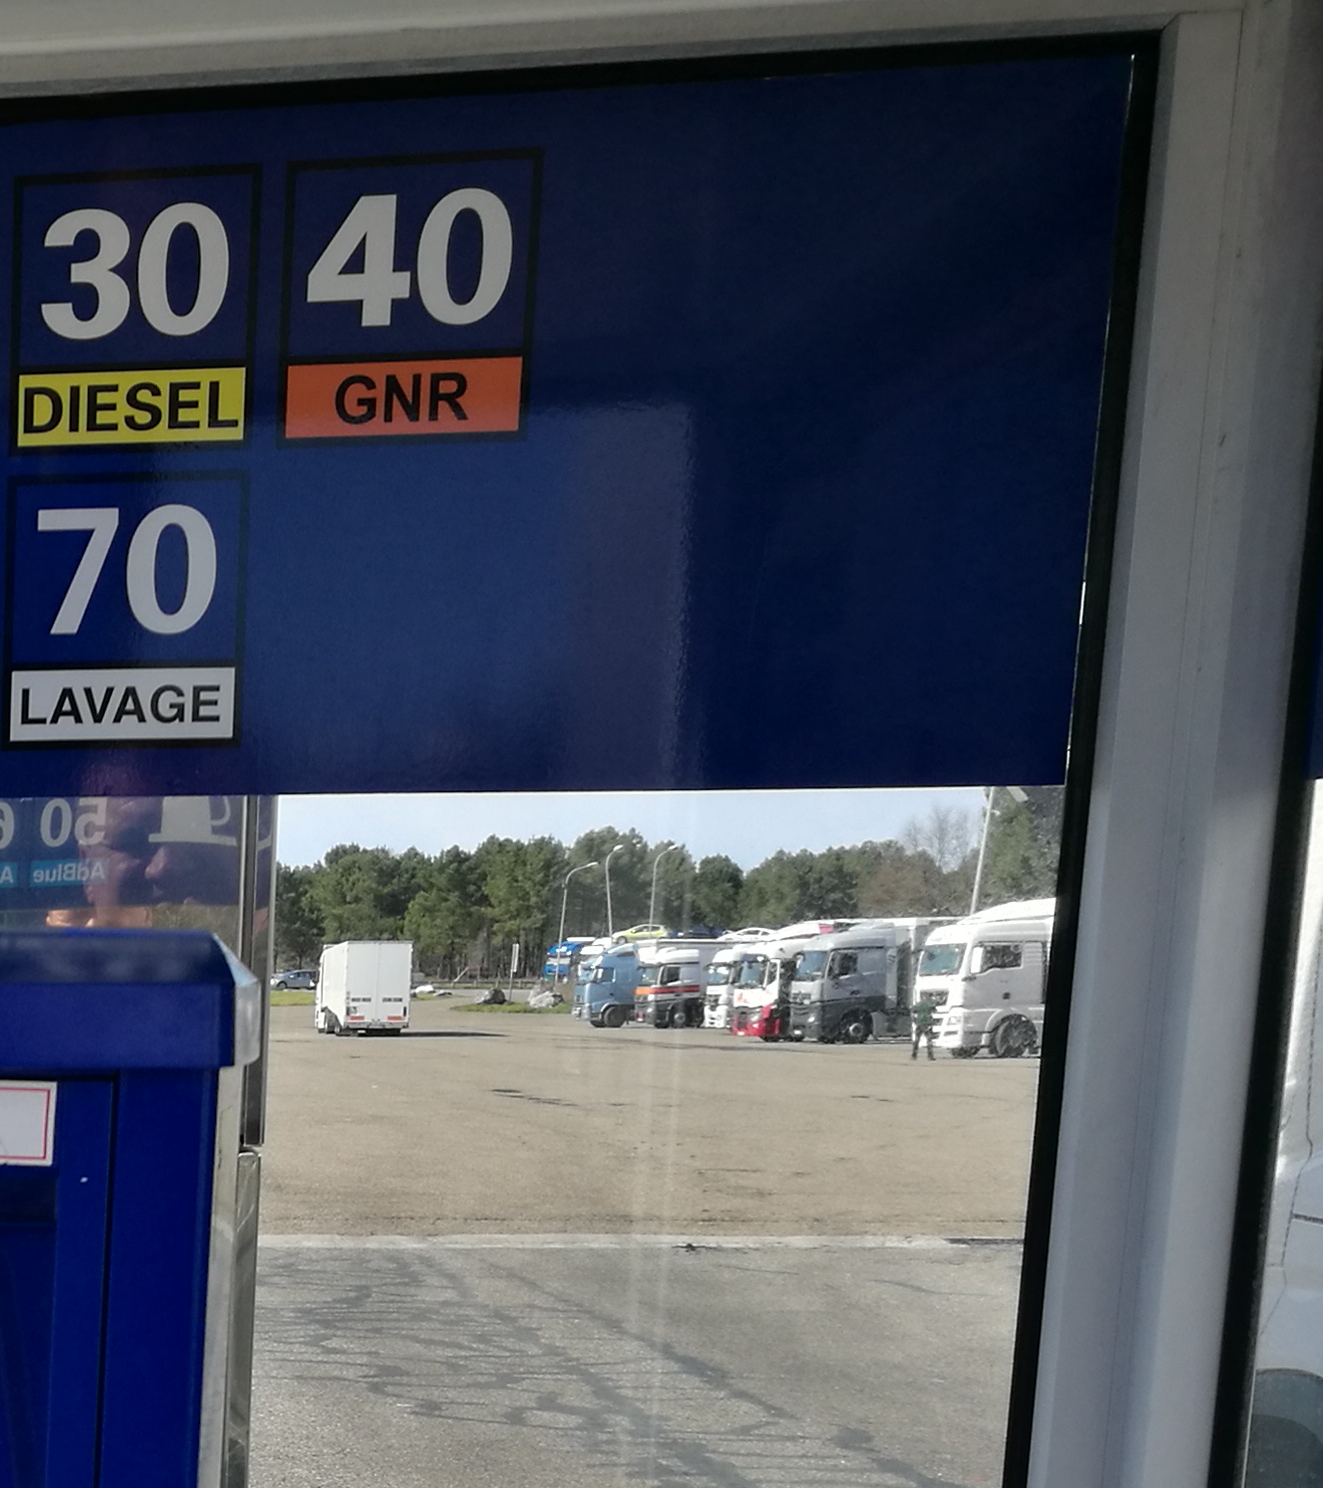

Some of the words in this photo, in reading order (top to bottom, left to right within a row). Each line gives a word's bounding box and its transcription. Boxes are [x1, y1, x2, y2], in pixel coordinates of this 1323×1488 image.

[40, 202, 229, 340] 30
[306, 187, 514, 328] 40
[22, 382, 239, 435] DIESEL
[334, 373, 468, 426] GNR
[36, 504, 217, 636] 70
[20, 685, 221, 726] LAVAGE
